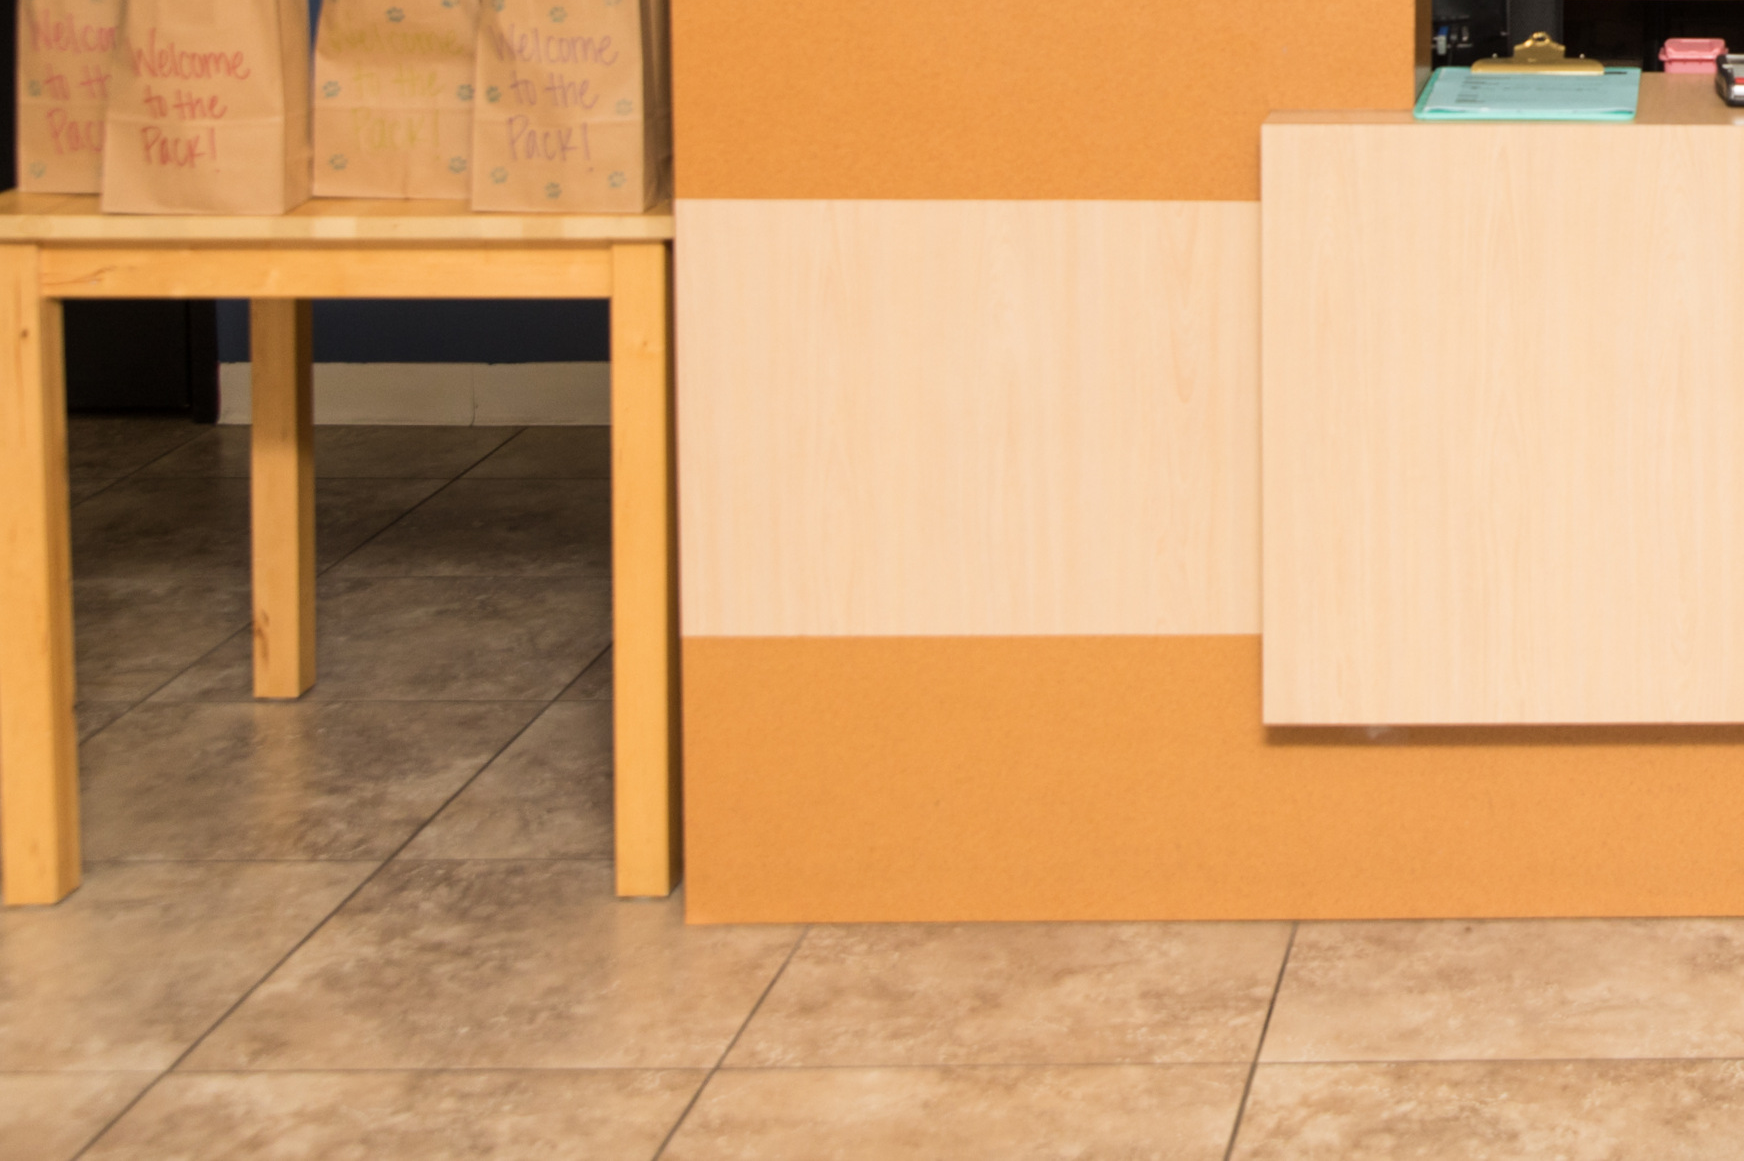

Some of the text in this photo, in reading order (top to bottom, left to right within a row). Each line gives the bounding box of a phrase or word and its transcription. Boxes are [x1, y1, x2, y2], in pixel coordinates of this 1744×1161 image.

[133, 27, 250, 80] Welcome
[144, 85, 228, 120] to the
[140, 125, 221, 174] Pack!
